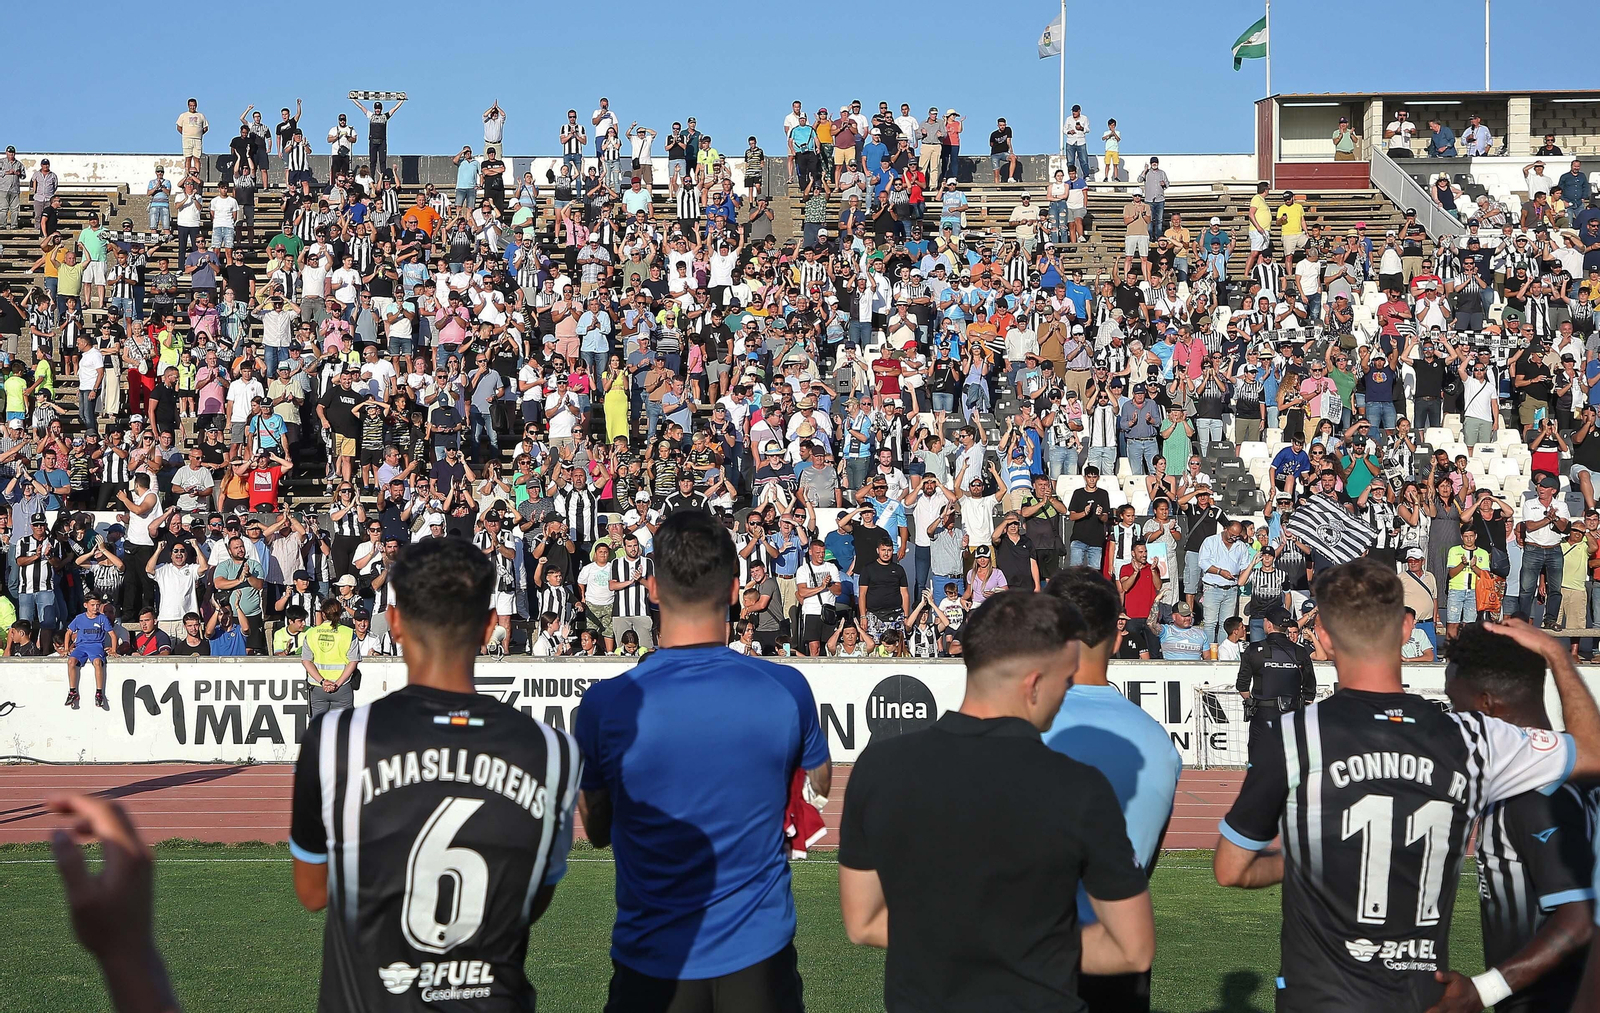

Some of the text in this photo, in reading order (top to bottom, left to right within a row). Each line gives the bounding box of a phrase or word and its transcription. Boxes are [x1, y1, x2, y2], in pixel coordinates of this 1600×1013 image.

[340, 396, 355, 404] VANS
[523, 678, 600, 697] INDUS
[871, 696, 927, 719] linea
[361, 747, 548, 820] J.MASLLORENS
[1329, 752, 1434, 788] CONNOR
[400, 796, 489, 955] 6
[1341, 794, 1455, 927] 11
